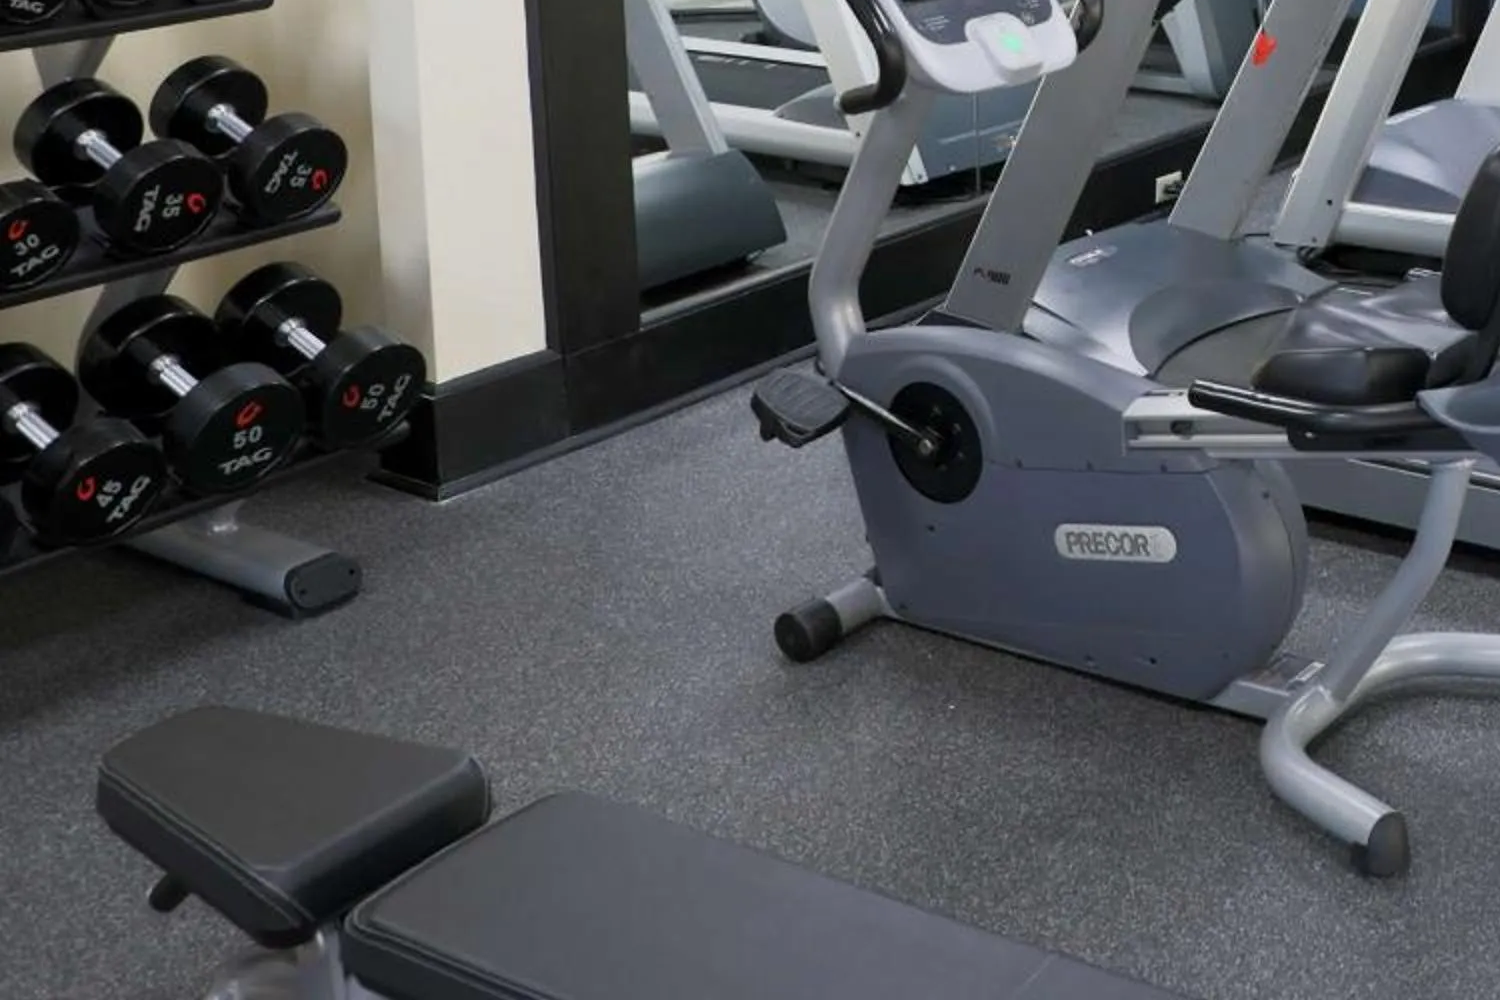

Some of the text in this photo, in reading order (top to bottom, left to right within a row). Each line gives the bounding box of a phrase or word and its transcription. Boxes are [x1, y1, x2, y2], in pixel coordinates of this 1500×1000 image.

[264, 149, 299, 194] TAG
[134, 184, 161, 234] TAG
[162, 194, 184, 218] 35
[14, 234, 40, 256] 30
[10, 244, 61, 278] TAG
[359, 382, 385, 411] 50
[376, 373, 412, 423] TAG
[233, 426, 264, 448] 50
[218, 446, 274, 476] TAG
[96, 479, 123, 509] 45
[106, 475, 151, 524] TAG
[1065, 531, 1150, 557] PRECOR
